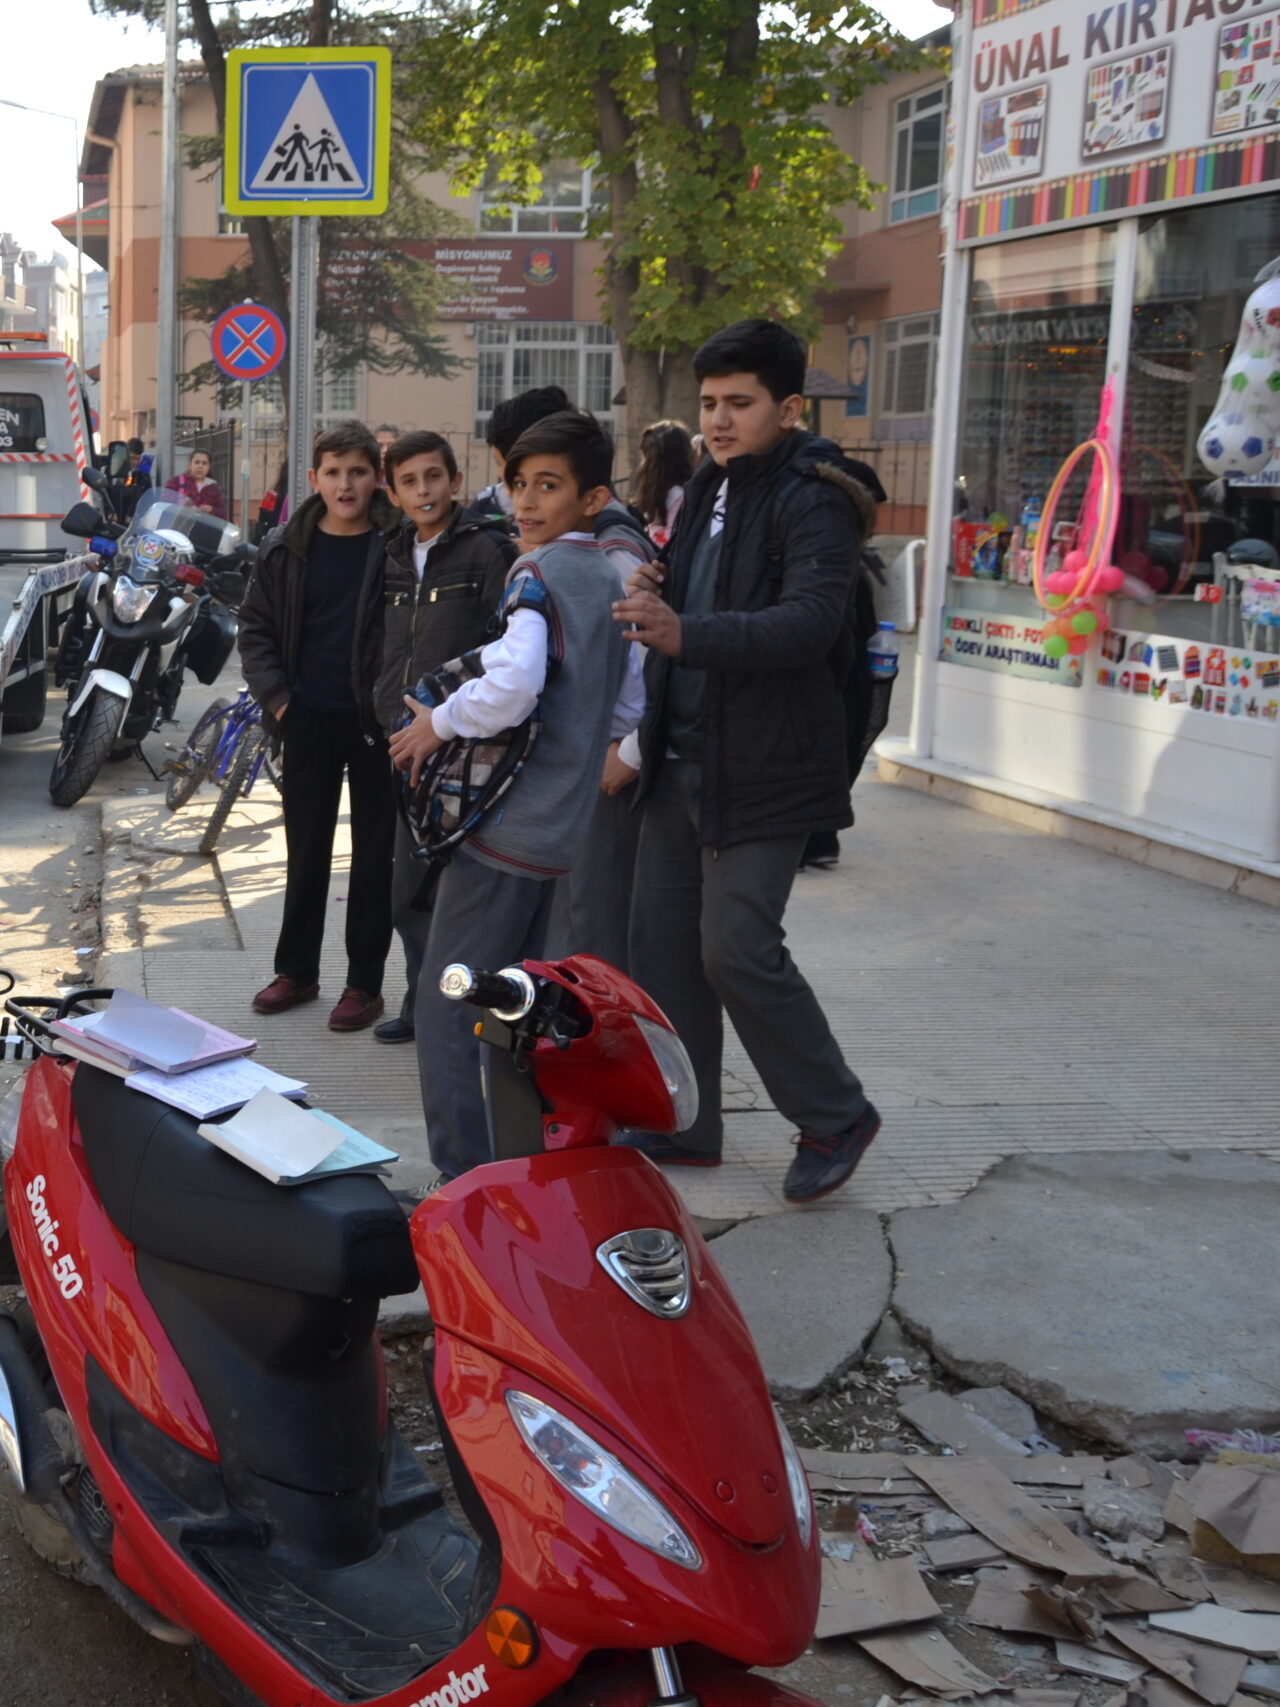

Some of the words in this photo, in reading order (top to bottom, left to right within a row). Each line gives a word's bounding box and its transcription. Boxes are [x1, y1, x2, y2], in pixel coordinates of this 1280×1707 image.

[974, 25, 1069, 93] ÜNAL
[435, 248, 512, 261] MİSYONUMUZ
[955, 636, 983, 656] ÖDEV
[26, 1174, 60, 1257] Sonic
[52, 1253, 83, 1300] 50
